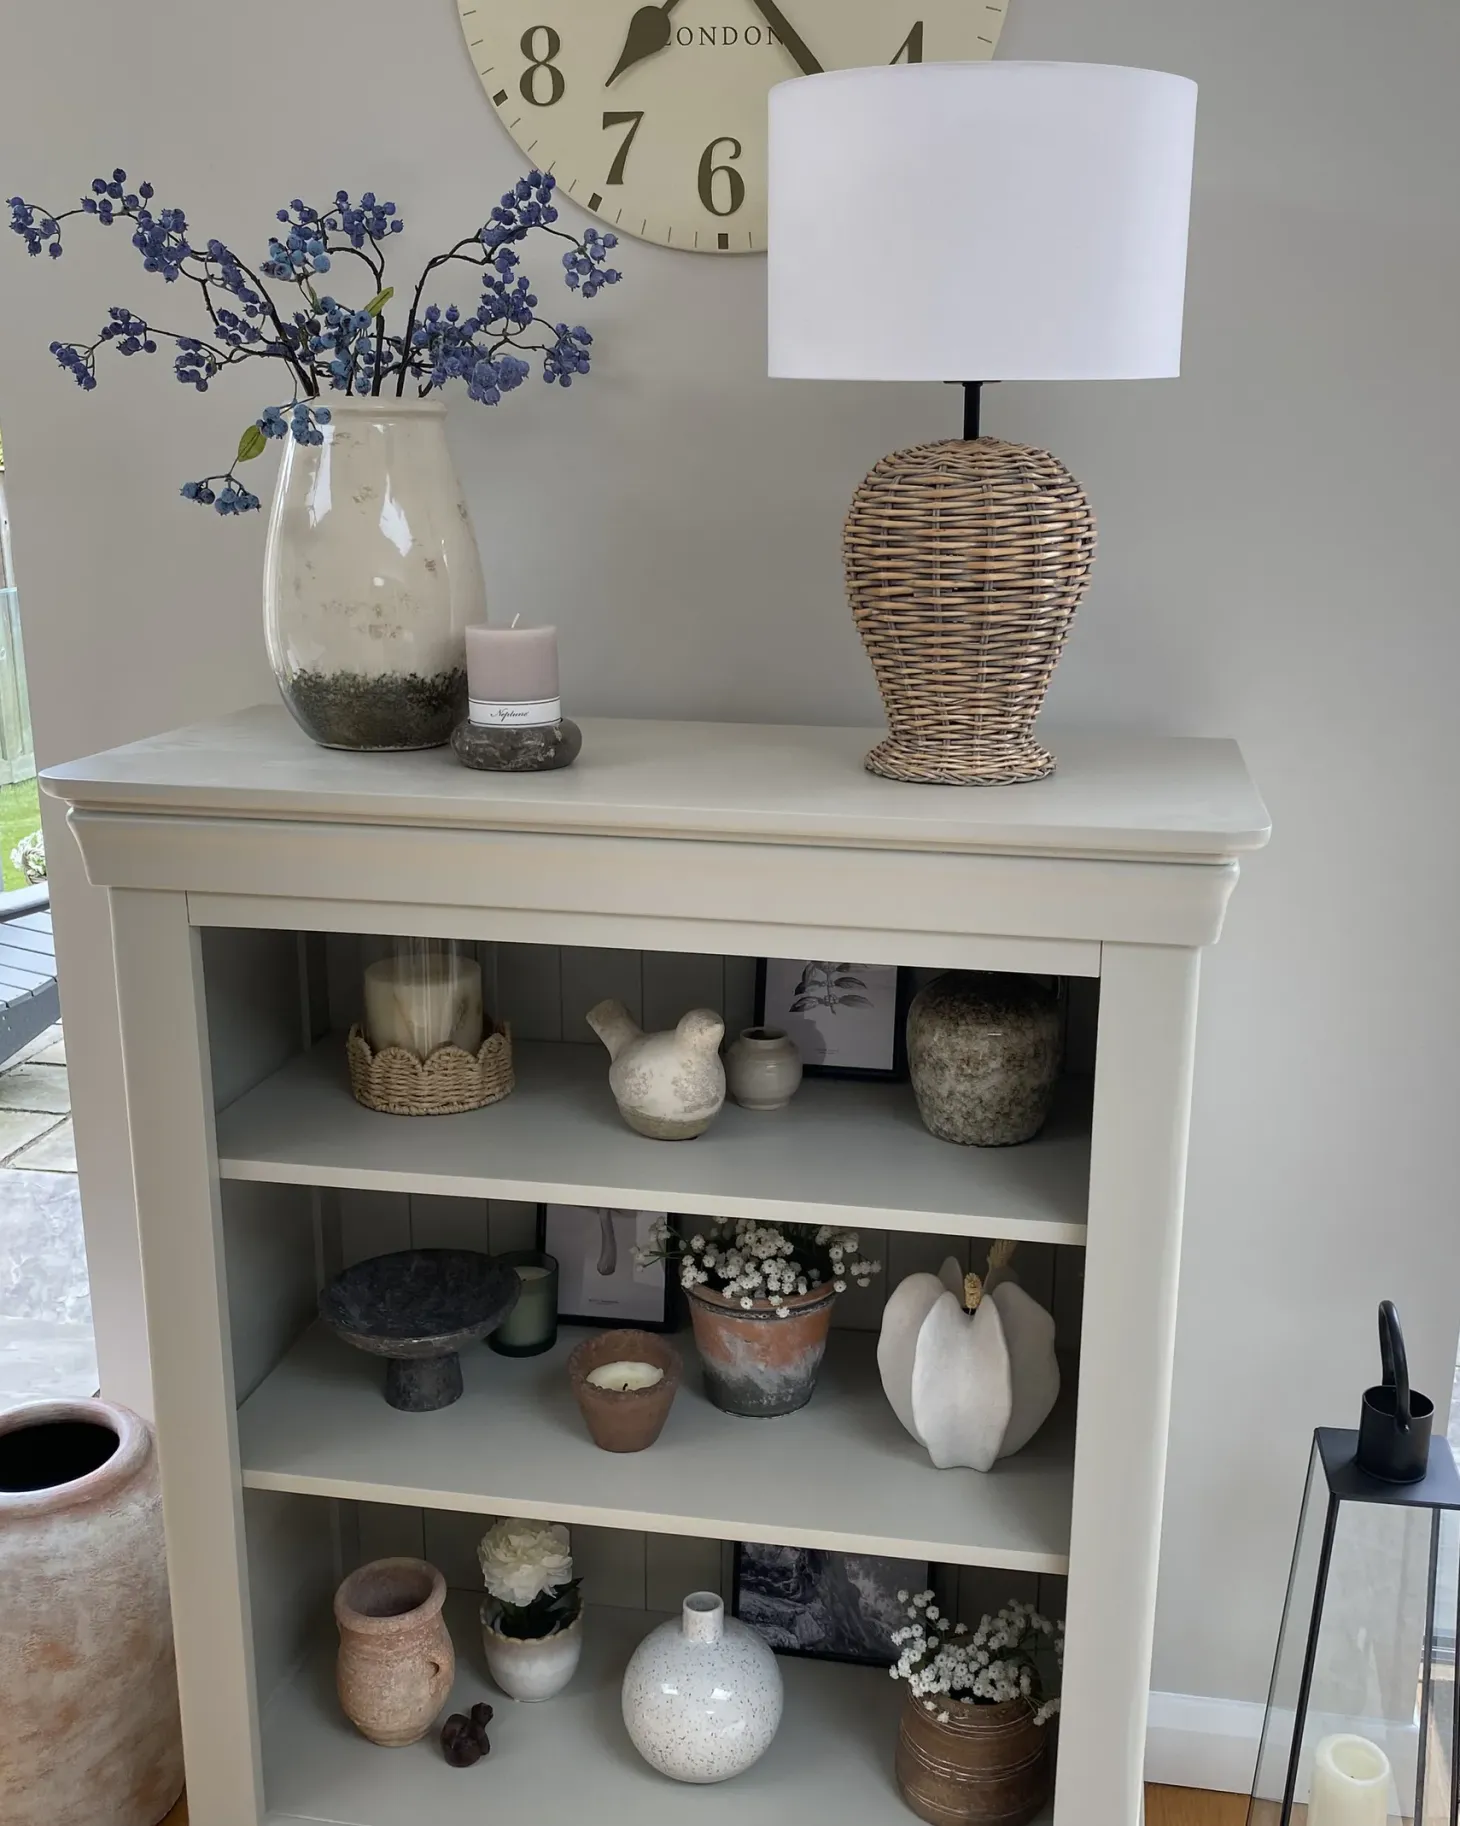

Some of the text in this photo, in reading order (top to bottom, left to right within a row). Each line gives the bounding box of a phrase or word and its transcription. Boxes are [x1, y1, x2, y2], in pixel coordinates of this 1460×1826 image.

[519, 25, 565, 107] 8
[666, 26, 784, 46] ONDON
[602, 111, 644, 185] 7
[698, 136, 745, 216] 6
[490, 707, 529, 722] Neptune
